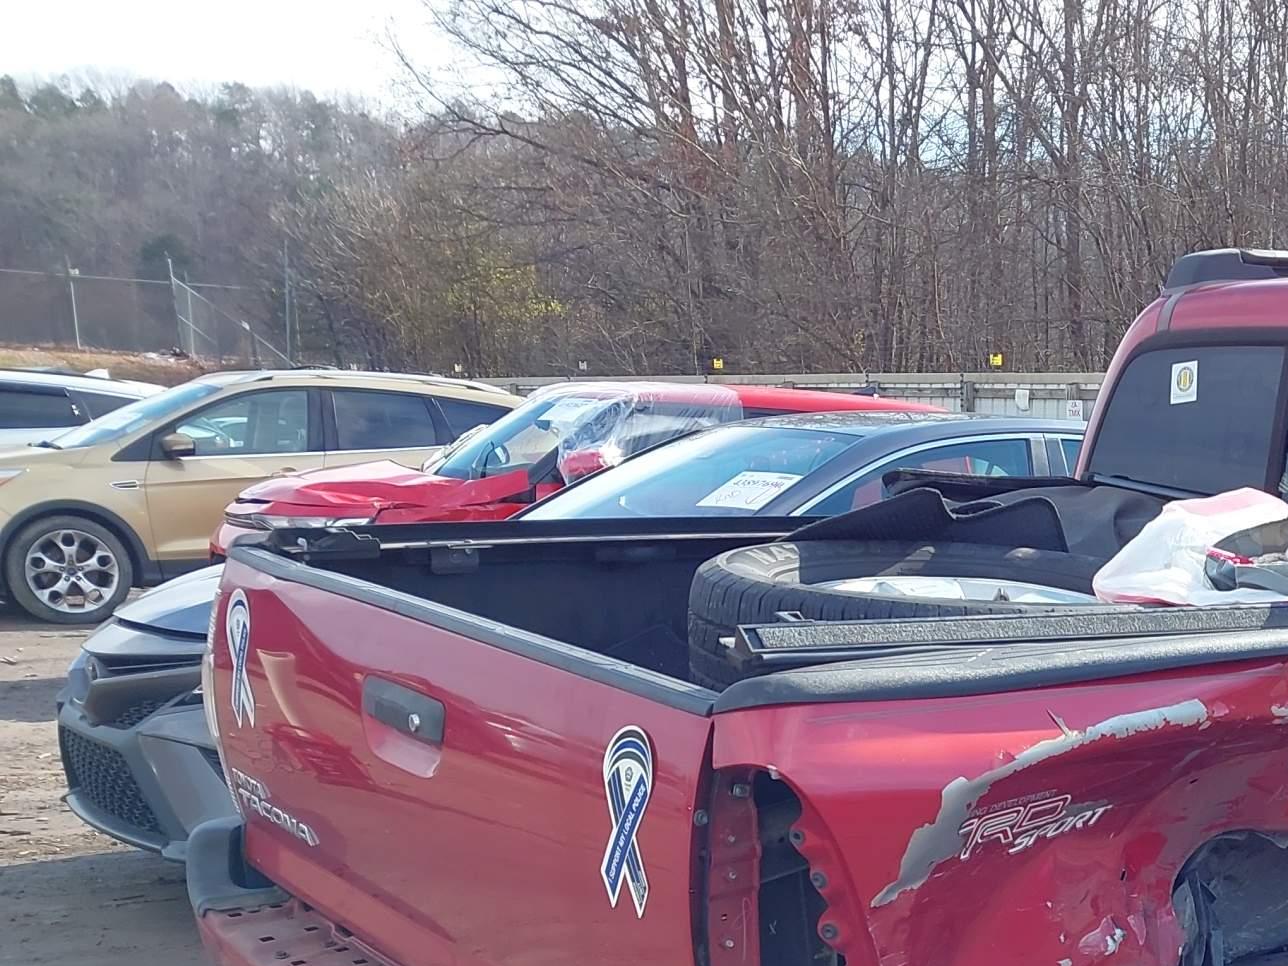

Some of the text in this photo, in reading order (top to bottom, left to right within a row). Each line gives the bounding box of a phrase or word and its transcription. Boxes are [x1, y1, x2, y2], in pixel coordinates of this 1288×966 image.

[239, 788, 320, 846] TACOMA
[609, 847, 622, 880] SUPPORT
[623, 812, 635, 834] LOCAL
[633, 786, 646, 812] POLICE
[958, 794, 1072, 860] TRD
[1008, 804, 1113, 854] SPORT
